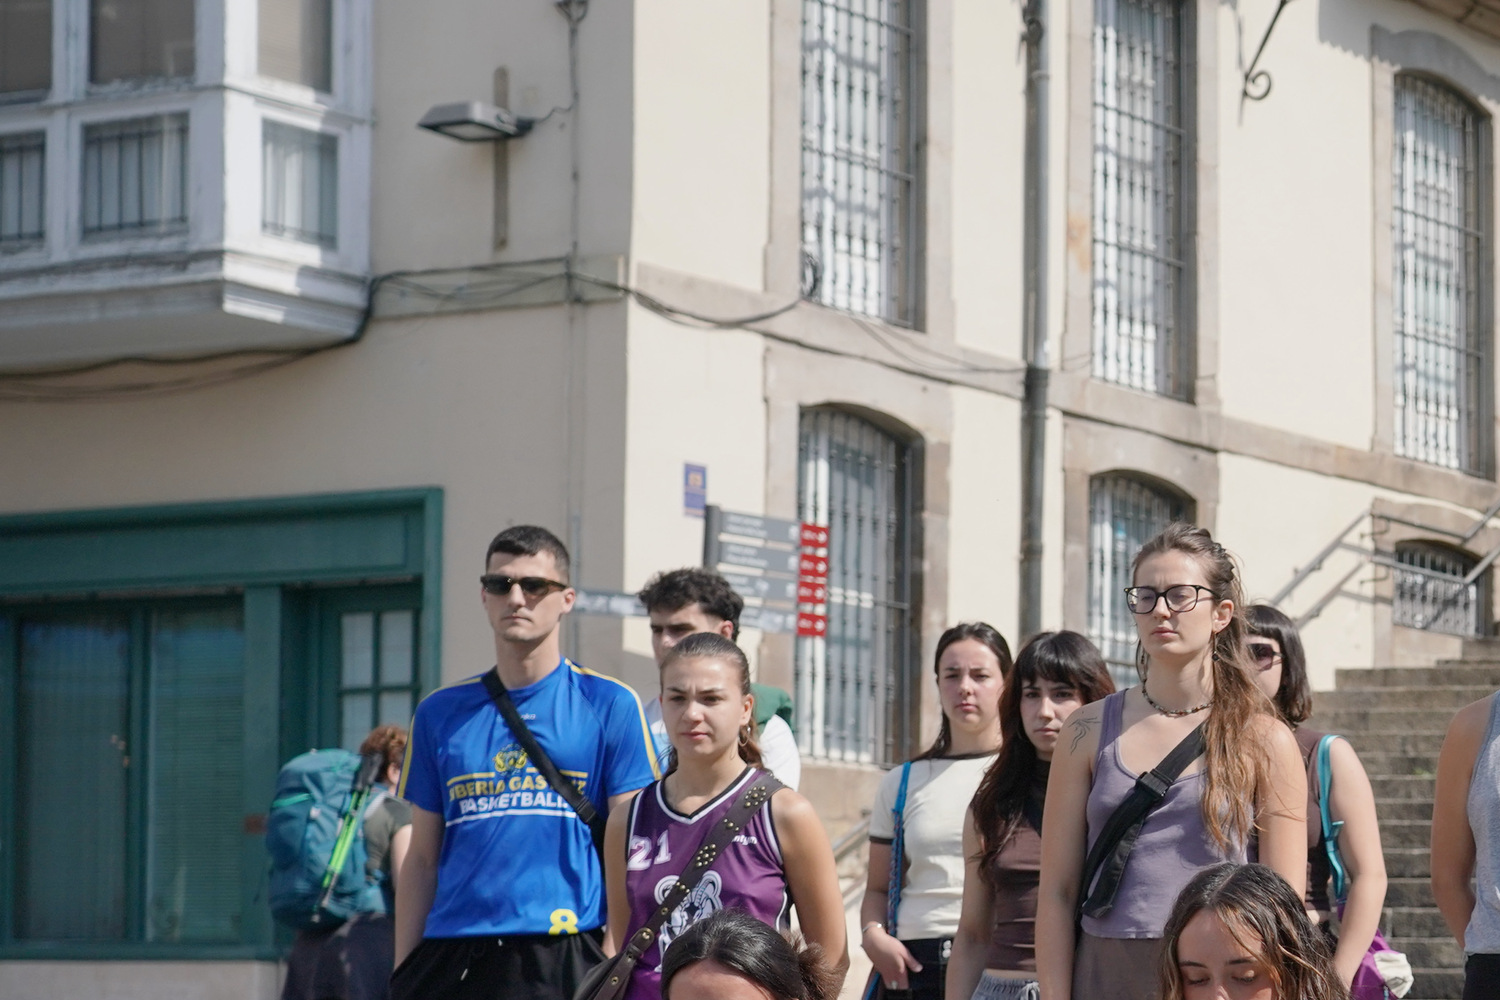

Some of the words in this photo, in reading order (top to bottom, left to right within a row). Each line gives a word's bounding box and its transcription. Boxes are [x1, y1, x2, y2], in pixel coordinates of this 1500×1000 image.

[508, 775, 587, 795] GASZ
[459, 791, 568, 815] BASKETBALL
[627, 830, 671, 871] 21
[549, 909, 579, 935] 8
